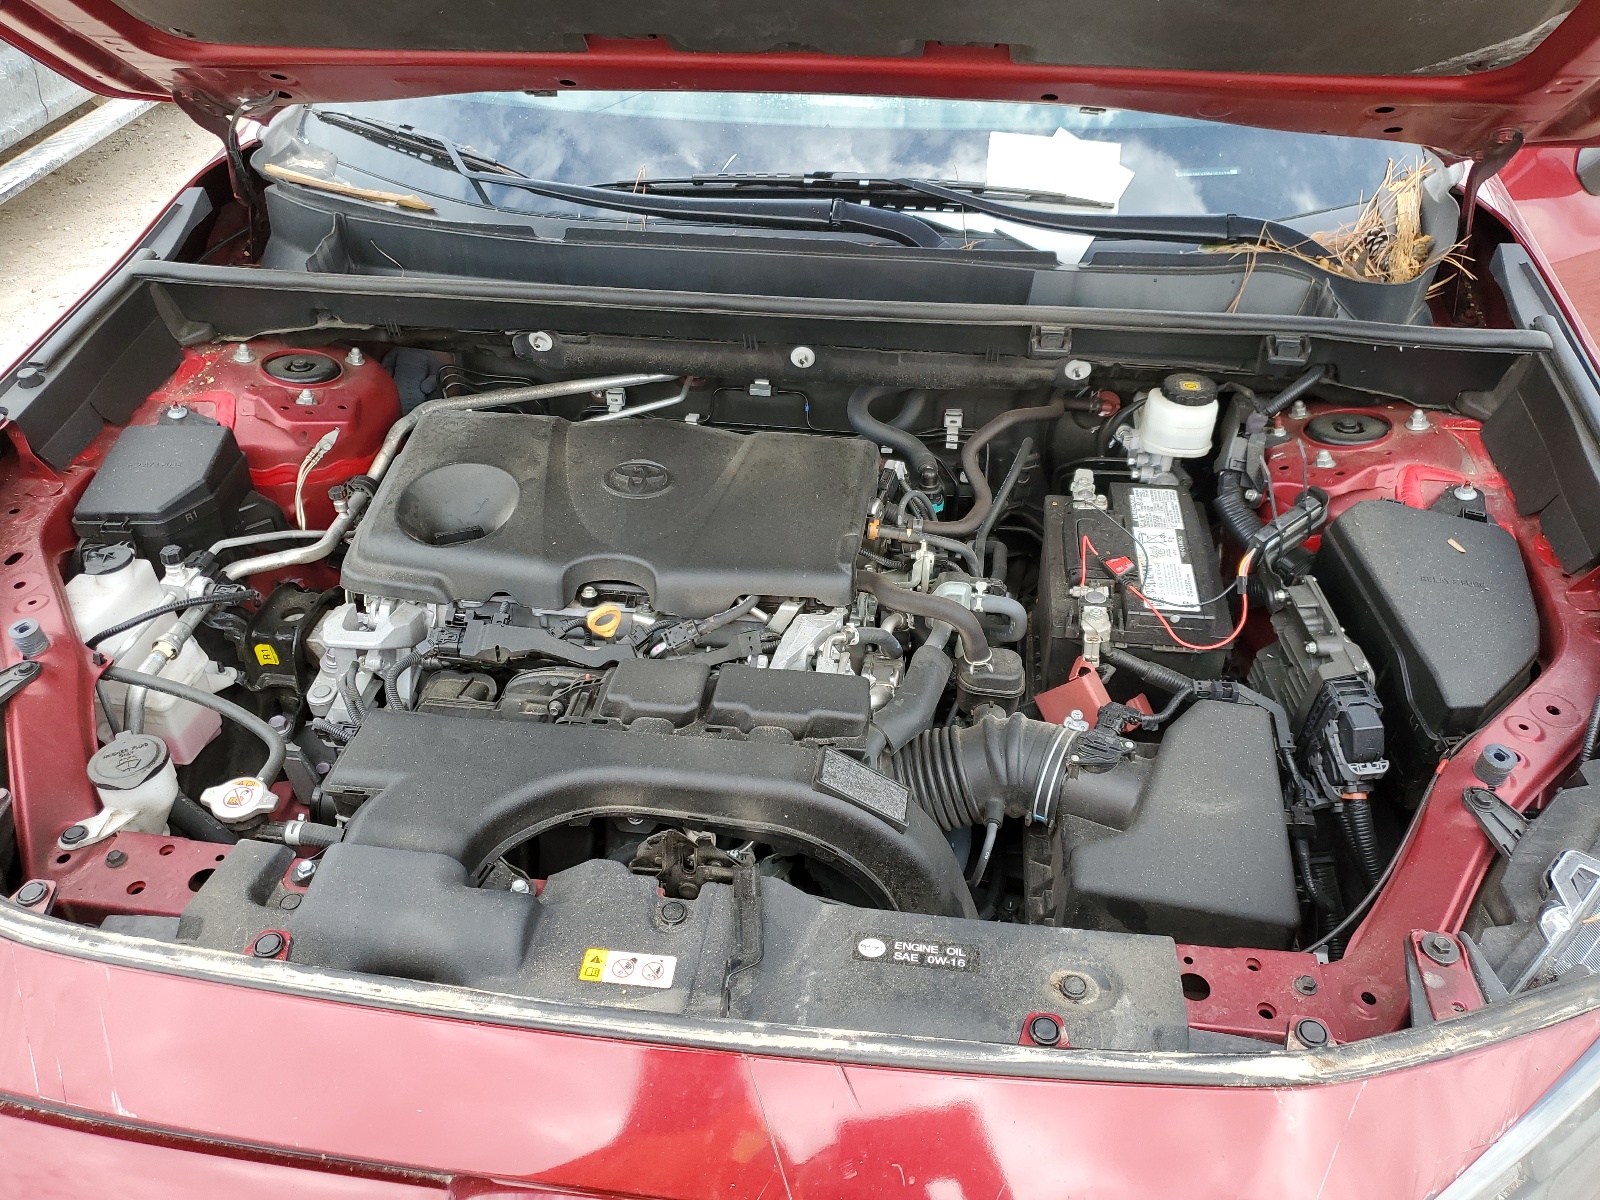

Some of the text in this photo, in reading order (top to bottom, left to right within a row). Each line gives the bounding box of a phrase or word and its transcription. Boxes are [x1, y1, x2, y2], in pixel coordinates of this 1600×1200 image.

[894, 941, 939, 954] ENGINE
[946, 947, 966, 957] OIL
[893, 951, 966, 968] SAE 0W-16
